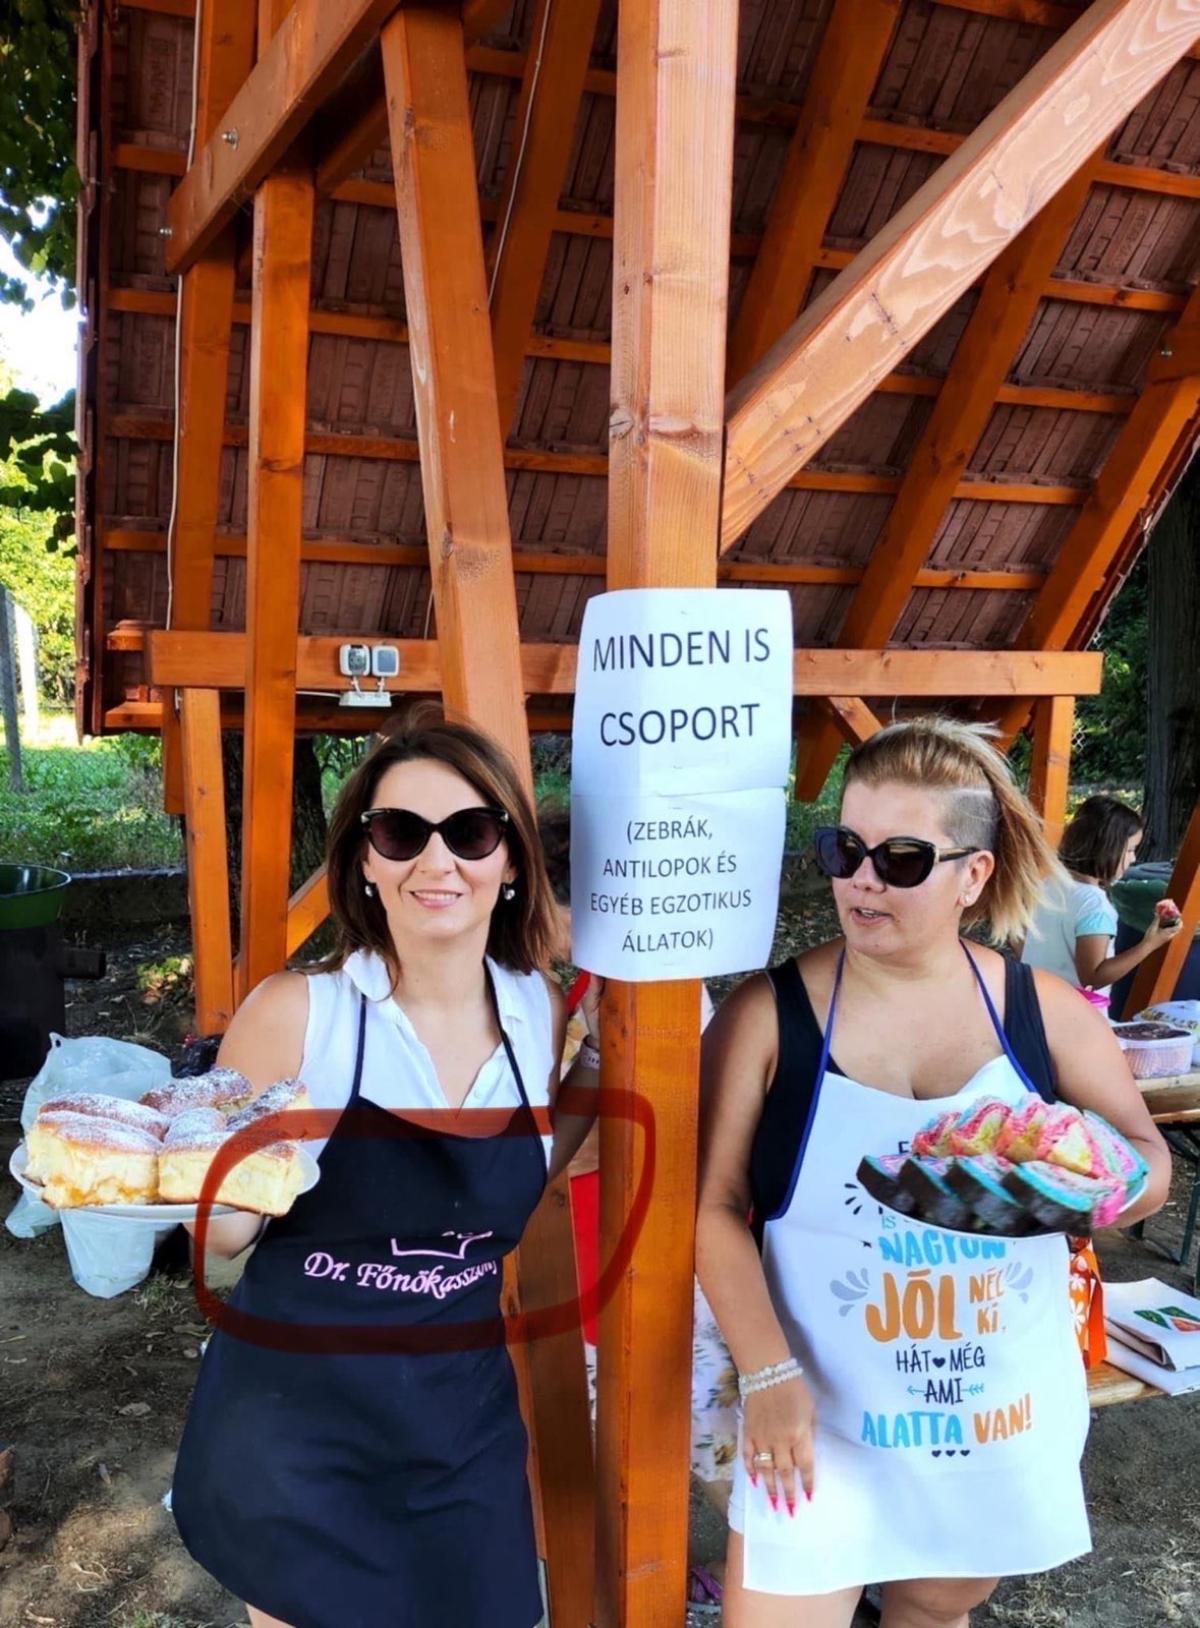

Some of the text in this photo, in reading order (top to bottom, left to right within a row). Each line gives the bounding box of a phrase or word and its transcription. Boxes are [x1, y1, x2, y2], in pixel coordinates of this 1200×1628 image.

[593, 628, 771, 671] MINDEN IS
[600, 703, 760, 747] CSOPORT
[626, 816, 714, 844] (ZEBRÁK,
[602, 853, 738, 879] ANTILOPOK ÉS
[590, 889, 752, 916] EGYÉB EGZOTIKUS
[621, 928, 714, 953] ÁLLATOK)
[303, 1252, 350, 1282] Dr.
[864, 1269, 963, 1343] JÓL
[895, 1343, 986, 1373] HÁT MÉG
[924, 1377, 964, 1406] AMI
[861, 1392, 1033, 1448] ALATTA VAN!
